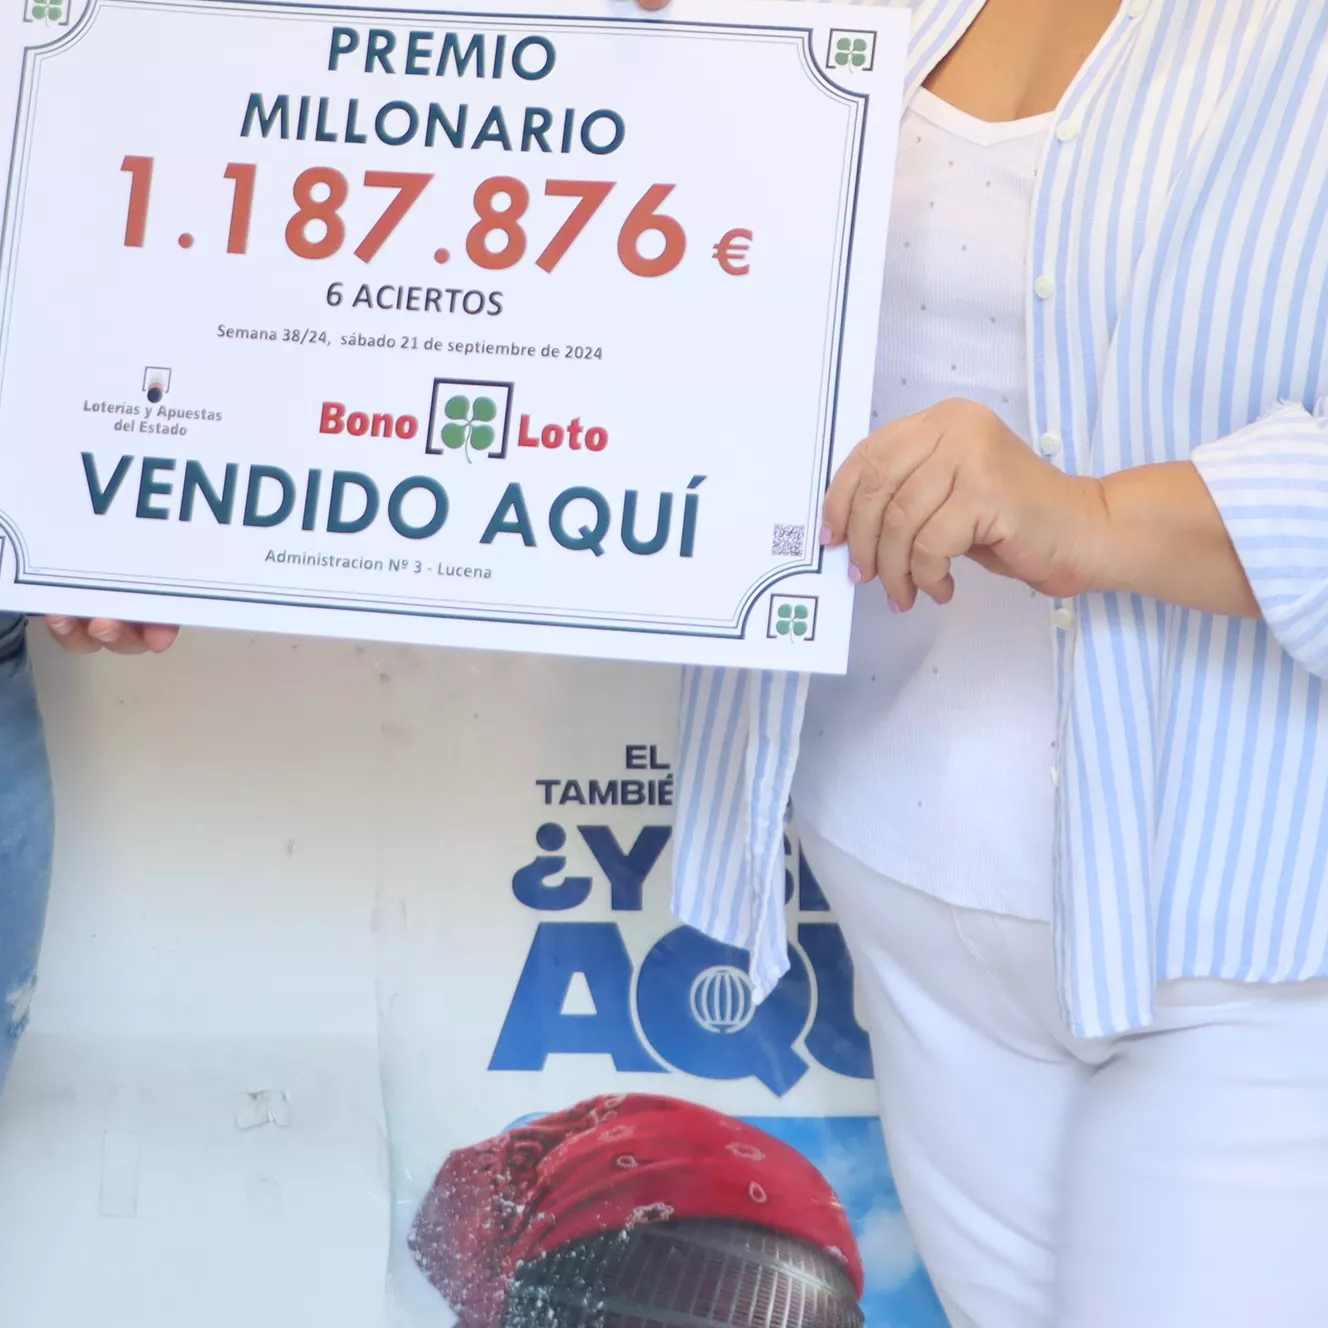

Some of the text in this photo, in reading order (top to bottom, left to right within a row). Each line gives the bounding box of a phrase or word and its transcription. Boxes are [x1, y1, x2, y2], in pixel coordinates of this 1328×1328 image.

[327, 26, 557, 83] PREMIO
[240, 93, 628, 157] MILLONARIO
[120, 155, 753, 279] 1.187.876 €
[325, 282, 504, 318] 6 ACIERTOS
[217, 325, 604, 361] Semana 38/24, sábado 21 de septiembre de 2024
[83, 400, 223, 422] Loterías y Apuestas
[114, 419, 188, 436] del Estado
[319, 401, 609, 452] Bono Loto
[79, 450, 708, 559] VENDIDO AQUÍ
[264, 549, 383, 571] Administracion
[388, 558, 409, 572] Nº
[413, 560, 422, 574] 3
[437, 562, 493, 579] Lucena
[625, 744, 671, 771] EL
[535, 774, 673, 806] TAMBIÉ
[512, 821, 673, 911] ¿Y
